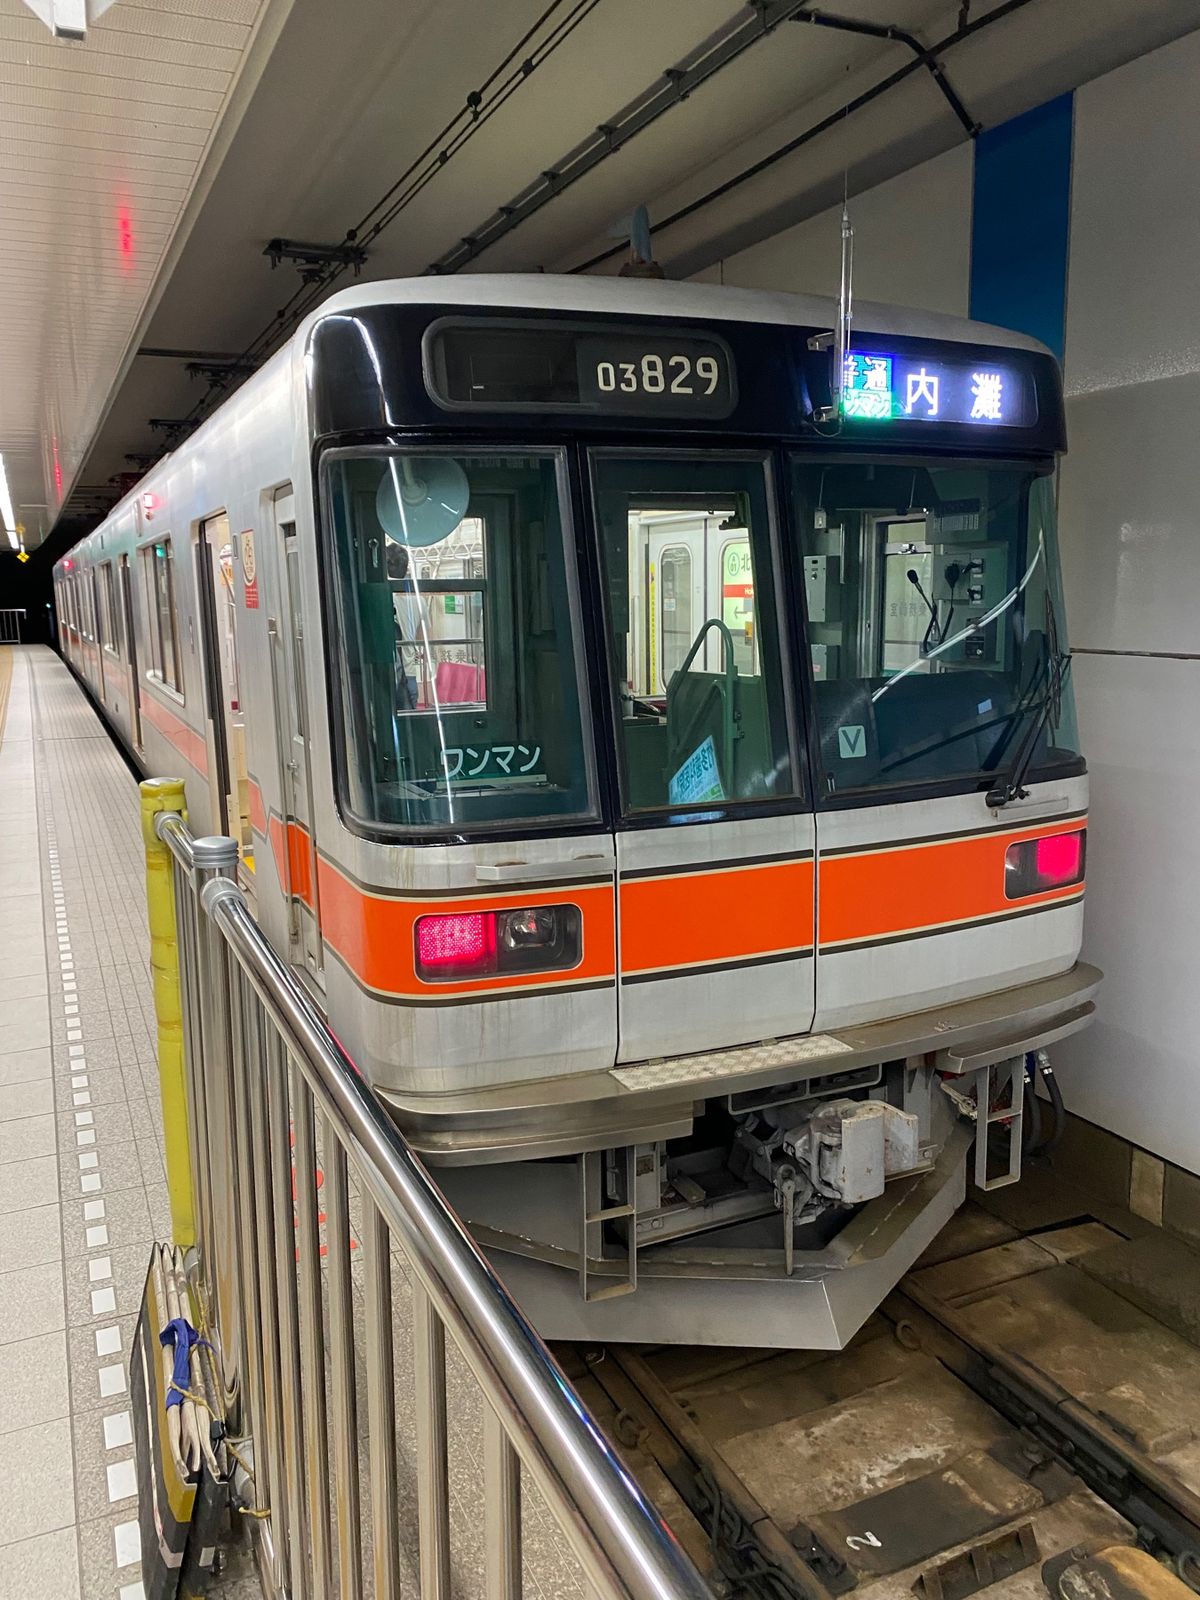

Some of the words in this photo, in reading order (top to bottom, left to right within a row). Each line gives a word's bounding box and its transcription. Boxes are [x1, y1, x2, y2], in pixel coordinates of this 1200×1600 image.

[597, 354, 719, 395] 03829
[841, 729, 861, 755] V
[440, 744, 541, 778] ワンマン
